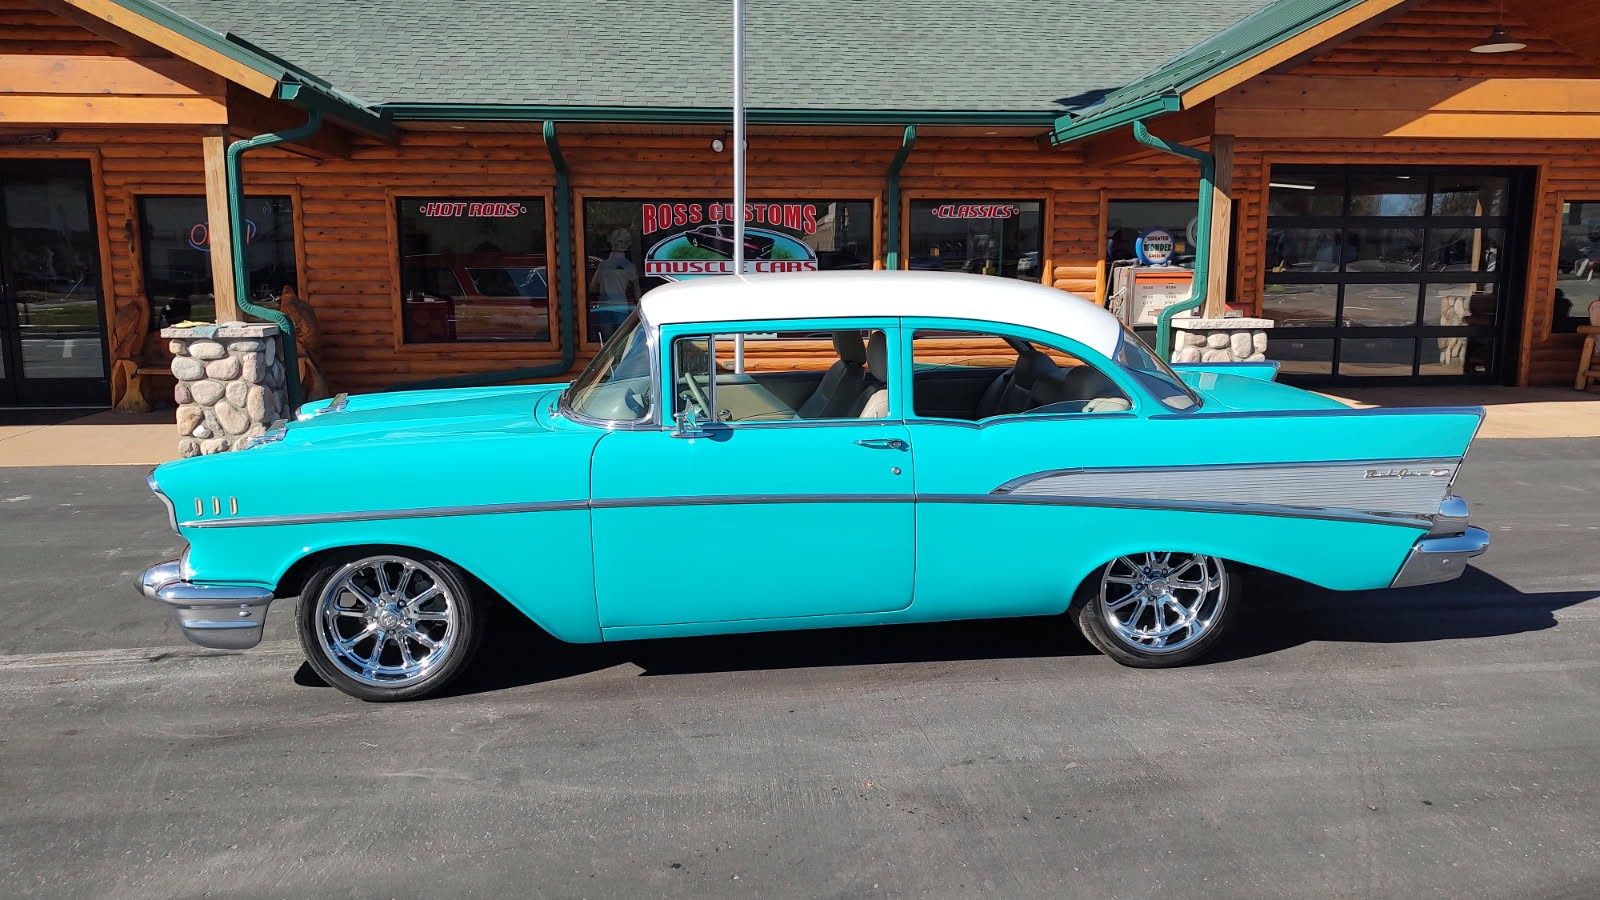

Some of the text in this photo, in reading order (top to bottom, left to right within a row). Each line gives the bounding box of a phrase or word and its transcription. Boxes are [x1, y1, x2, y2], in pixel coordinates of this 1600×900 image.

[426, 202, 520, 217] HOT RODS
[938, 204, 1013, 219] CLASSICS
[642, 203, 817, 236] ROSS CUSTOMS
[755, 261, 817, 273] CARS
